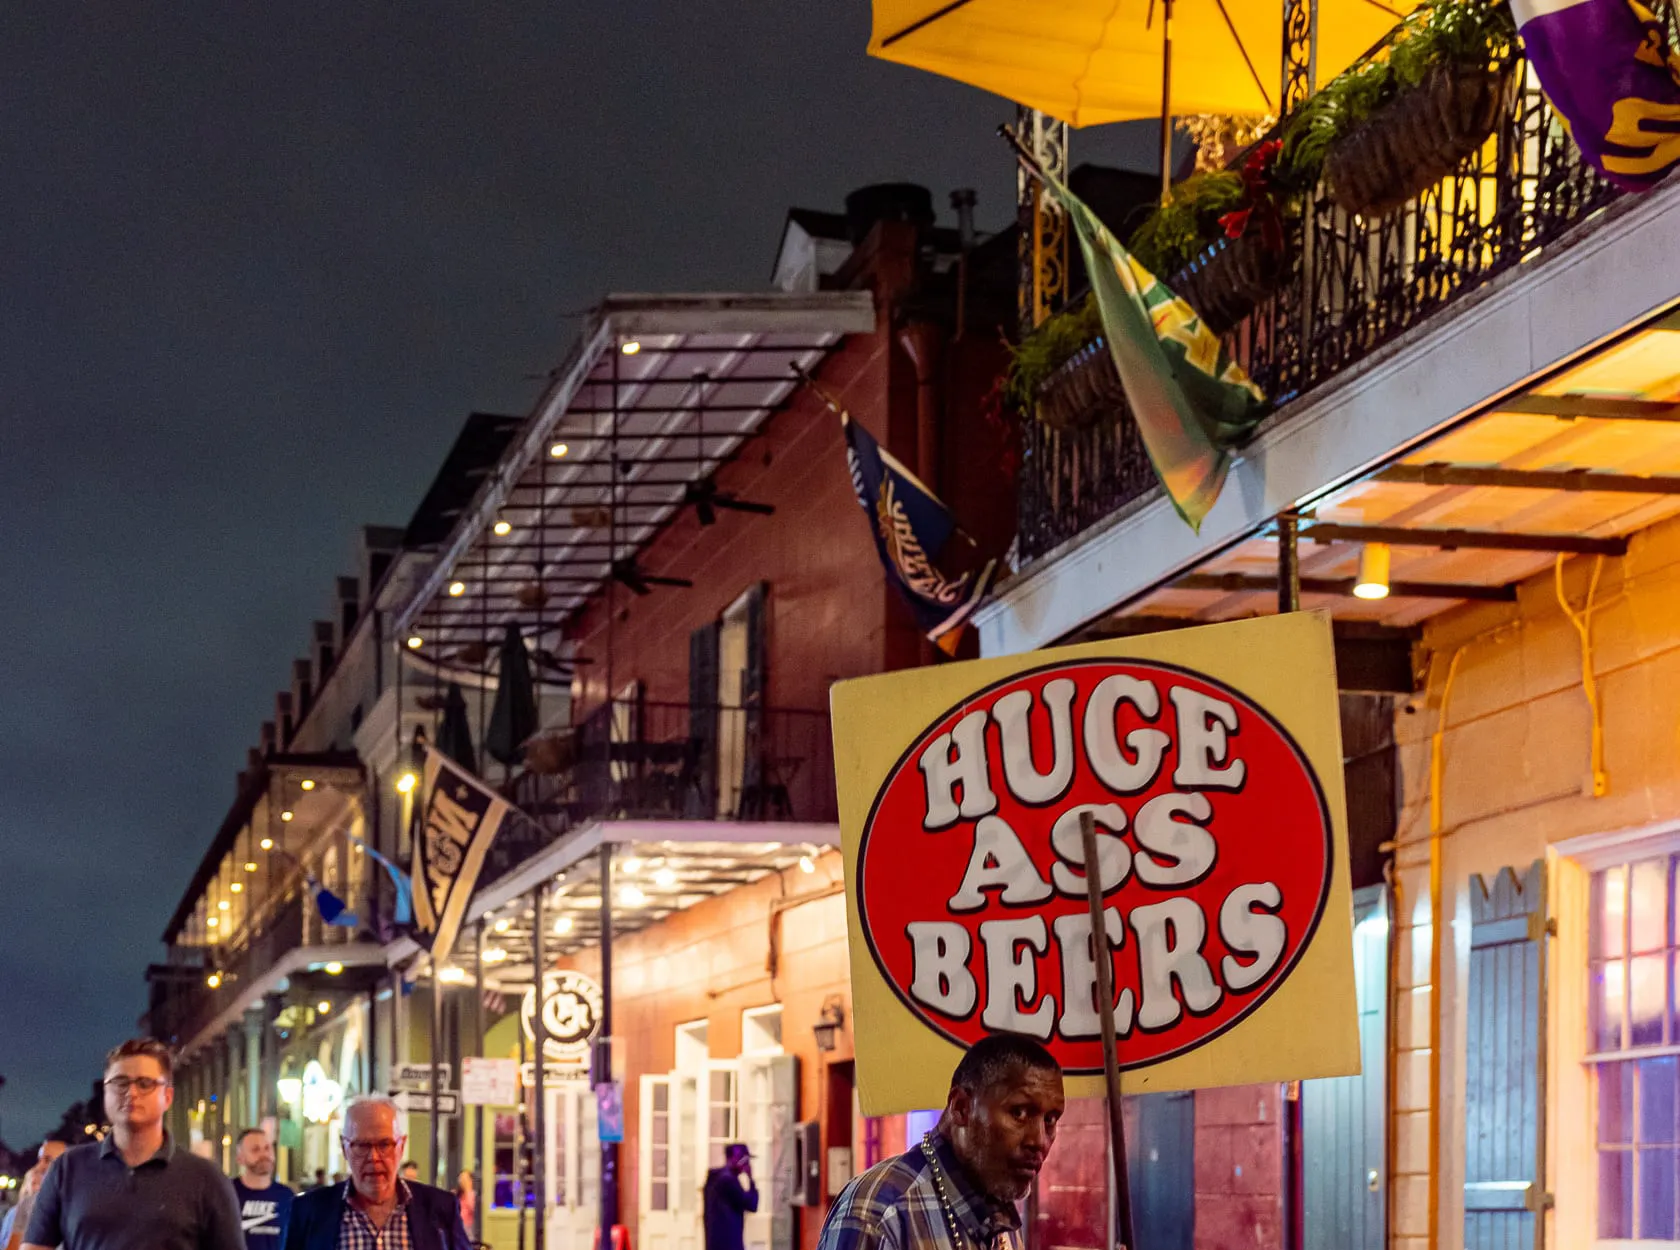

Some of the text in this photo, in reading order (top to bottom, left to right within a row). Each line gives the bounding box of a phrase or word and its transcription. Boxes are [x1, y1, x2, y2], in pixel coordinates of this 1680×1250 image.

[918, 673, 1246, 830] HUGE
[948, 790, 1217, 911] ASS
[906, 880, 1286, 1040] BEERS
